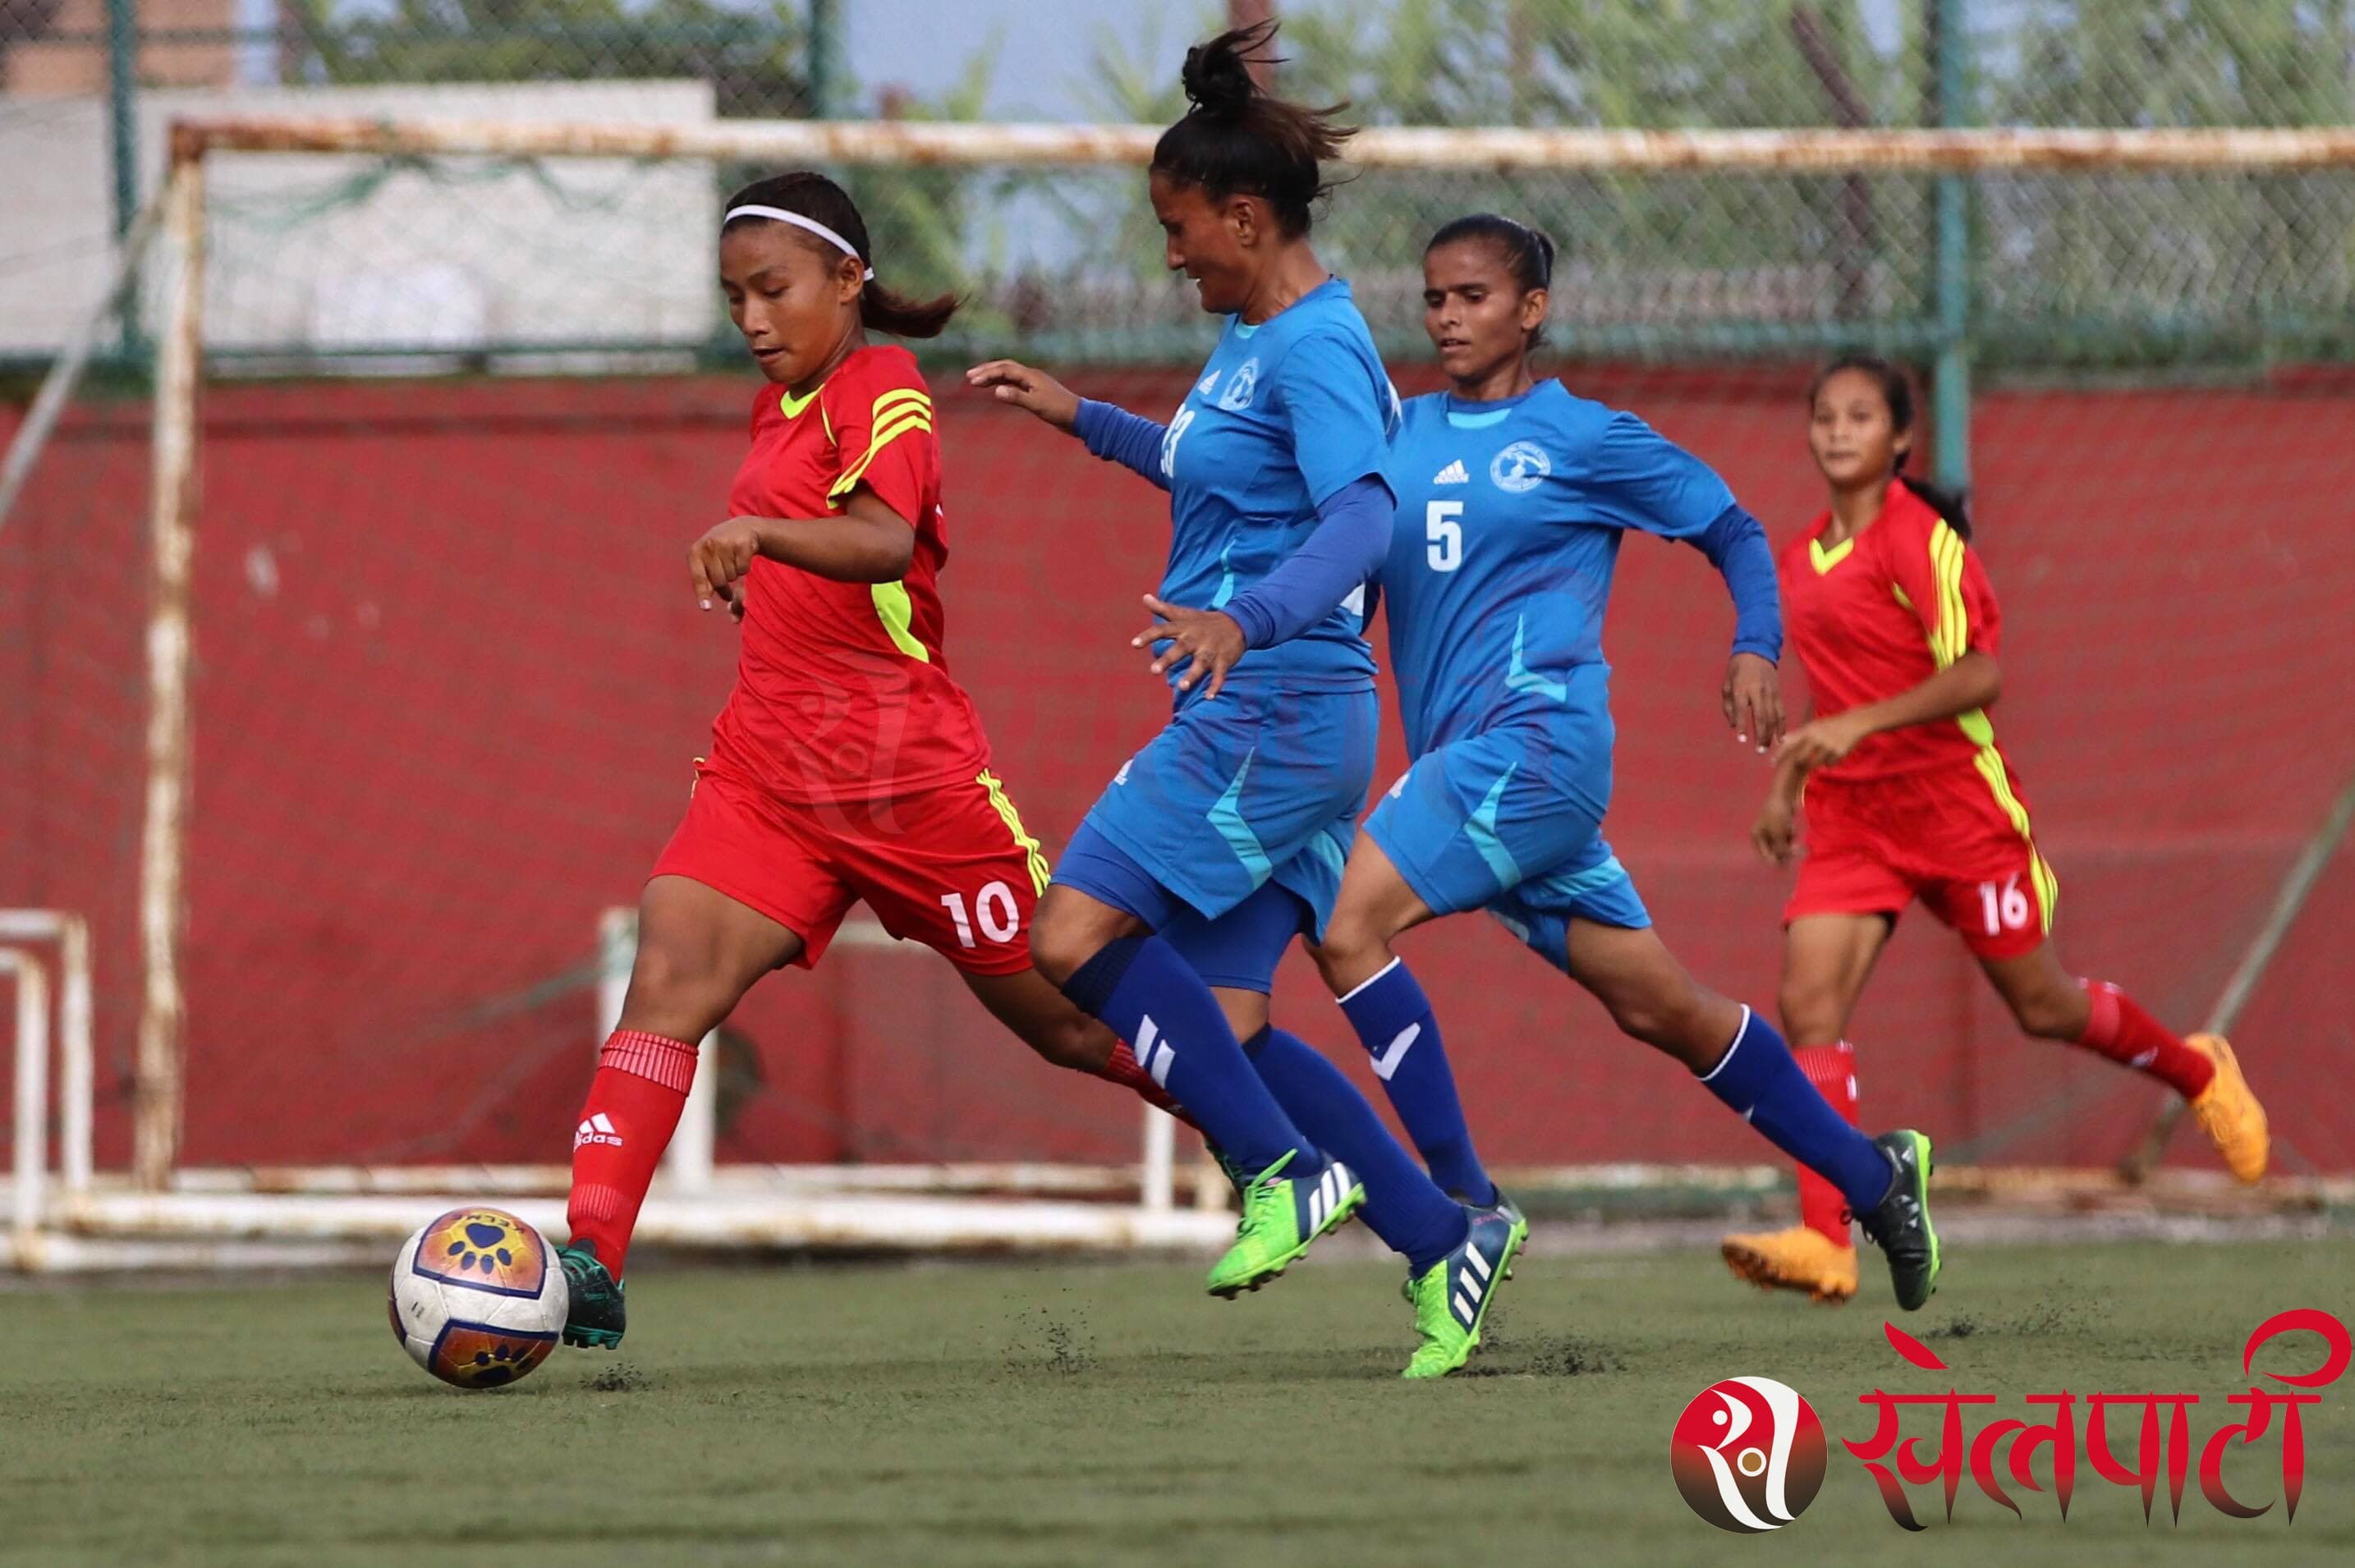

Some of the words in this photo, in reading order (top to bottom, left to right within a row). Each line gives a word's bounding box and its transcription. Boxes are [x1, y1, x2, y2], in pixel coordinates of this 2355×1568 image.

[1426, 499, 1464, 572] 5
[940, 880, 1020, 949] 10
[1979, 870, 2029, 936] 16
[572, 1130, 623, 1153] idas
